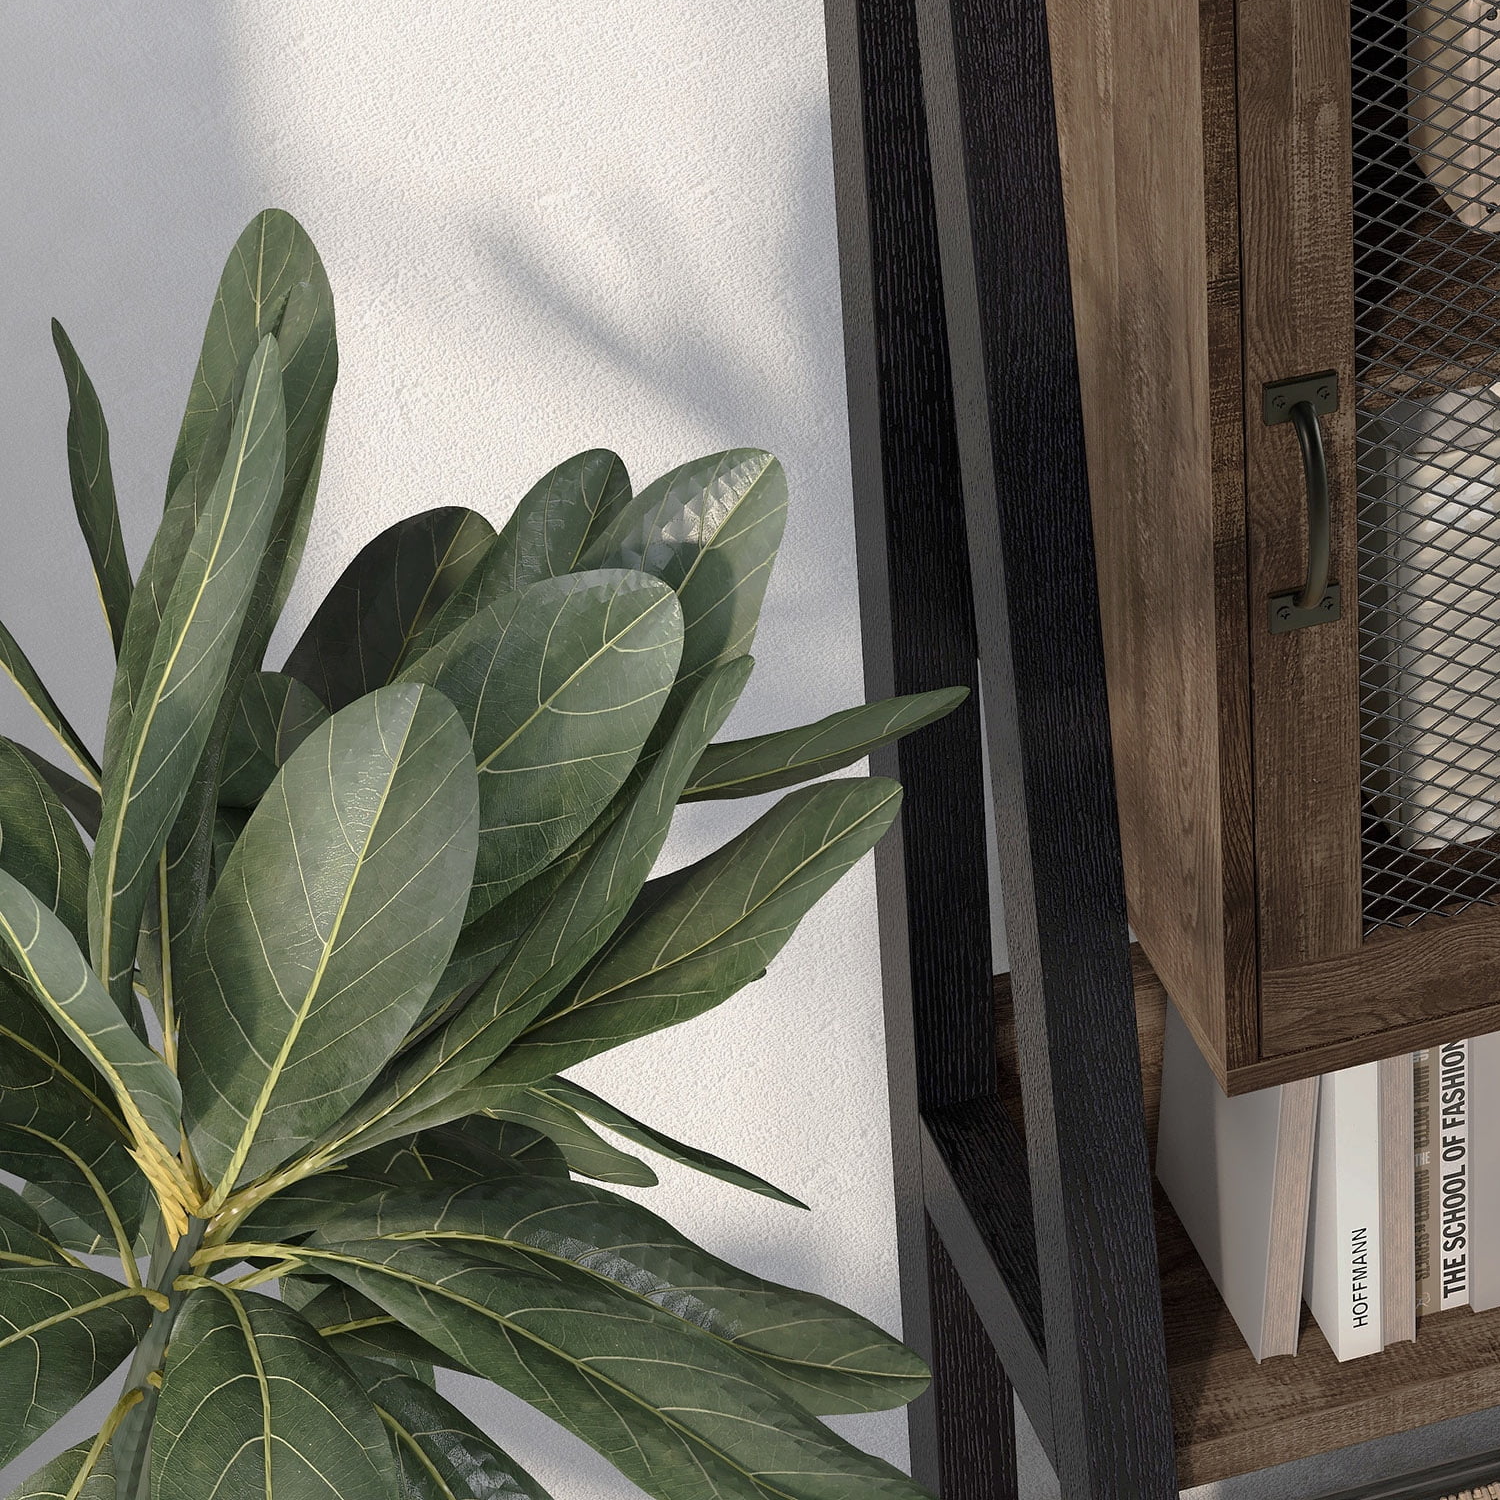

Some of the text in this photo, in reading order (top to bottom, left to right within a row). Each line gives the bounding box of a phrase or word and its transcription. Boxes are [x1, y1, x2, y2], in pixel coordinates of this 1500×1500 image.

[1442, 1135, 1465, 1162] OF
[1442, 1164, 1466, 1252] SCHOOL
[1351, 1227, 1369, 1329] HOFFMANN
[1443, 1253, 1466, 1299] THE
